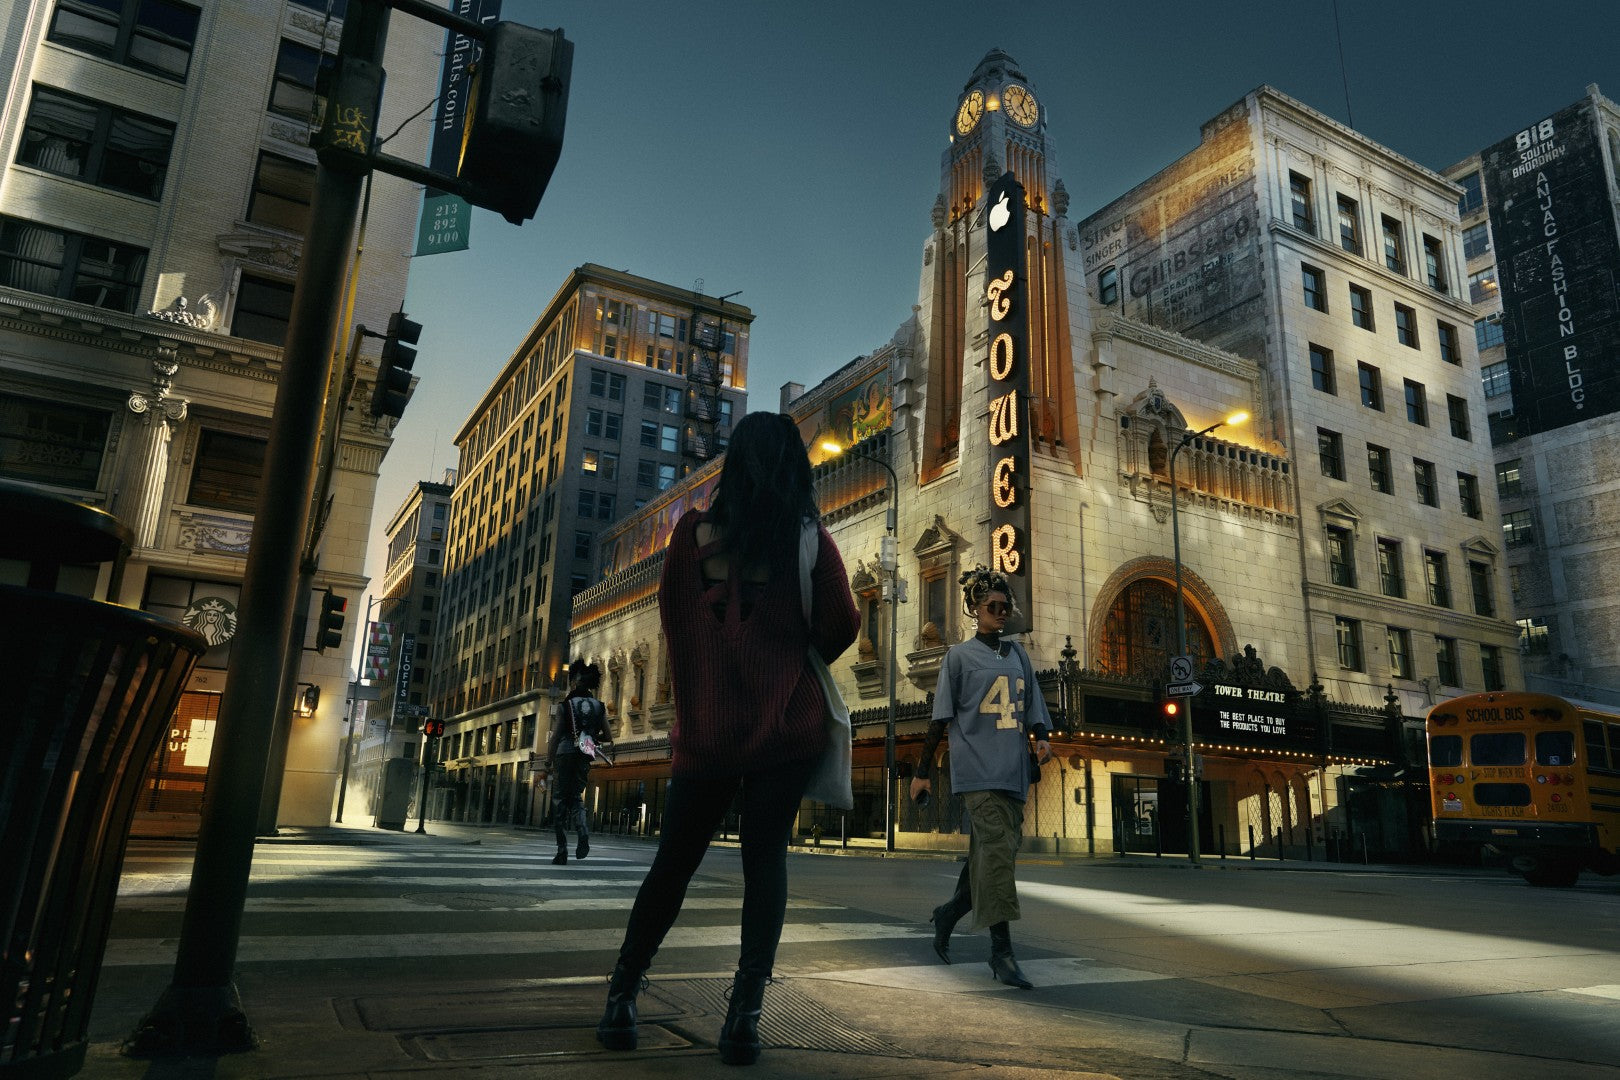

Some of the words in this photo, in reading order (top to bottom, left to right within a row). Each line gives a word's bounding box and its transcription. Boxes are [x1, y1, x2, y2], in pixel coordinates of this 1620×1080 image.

[1516, 118, 1555, 152] 818
[1520, 139, 1554, 164] SOUTH
[1512, 144, 1566, 179] BROADWAY
[435, 203, 458, 217] 213
[433, 217, 456, 231] 892
[428, 231, 459, 246] 9100
[1085, 239, 1123, 268] SINGER
[1536, 171, 1557, 238] ANJAC
[1547, 239, 1574, 338] FASHION
[988, 268, 1021, 574] TOWER
[401, 656, 411, 697] LOFTS
[1214, 684, 1243, 699] TOWER
[1247, 688, 1286, 703] THEATRE
[1219, 710, 1230, 720] THE
[1232, 712, 1245, 722] BEST
[1247, 714, 1265, 724] PLACE
[1266, 716, 1274, 724] TO
[1275, 717, 1286, 726] BUY
[1465, 707, 1503, 723] SCHOOL
[1504, 706, 1525, 721] BUS
[171, 728, 188, 740] PI
[1220, 720, 1231, 729] THE
[1232, 721, 1258, 732] PRODUCTS
[1260, 724, 1271, 734] YOU
[1272, 726, 1286, 735] LOVE
